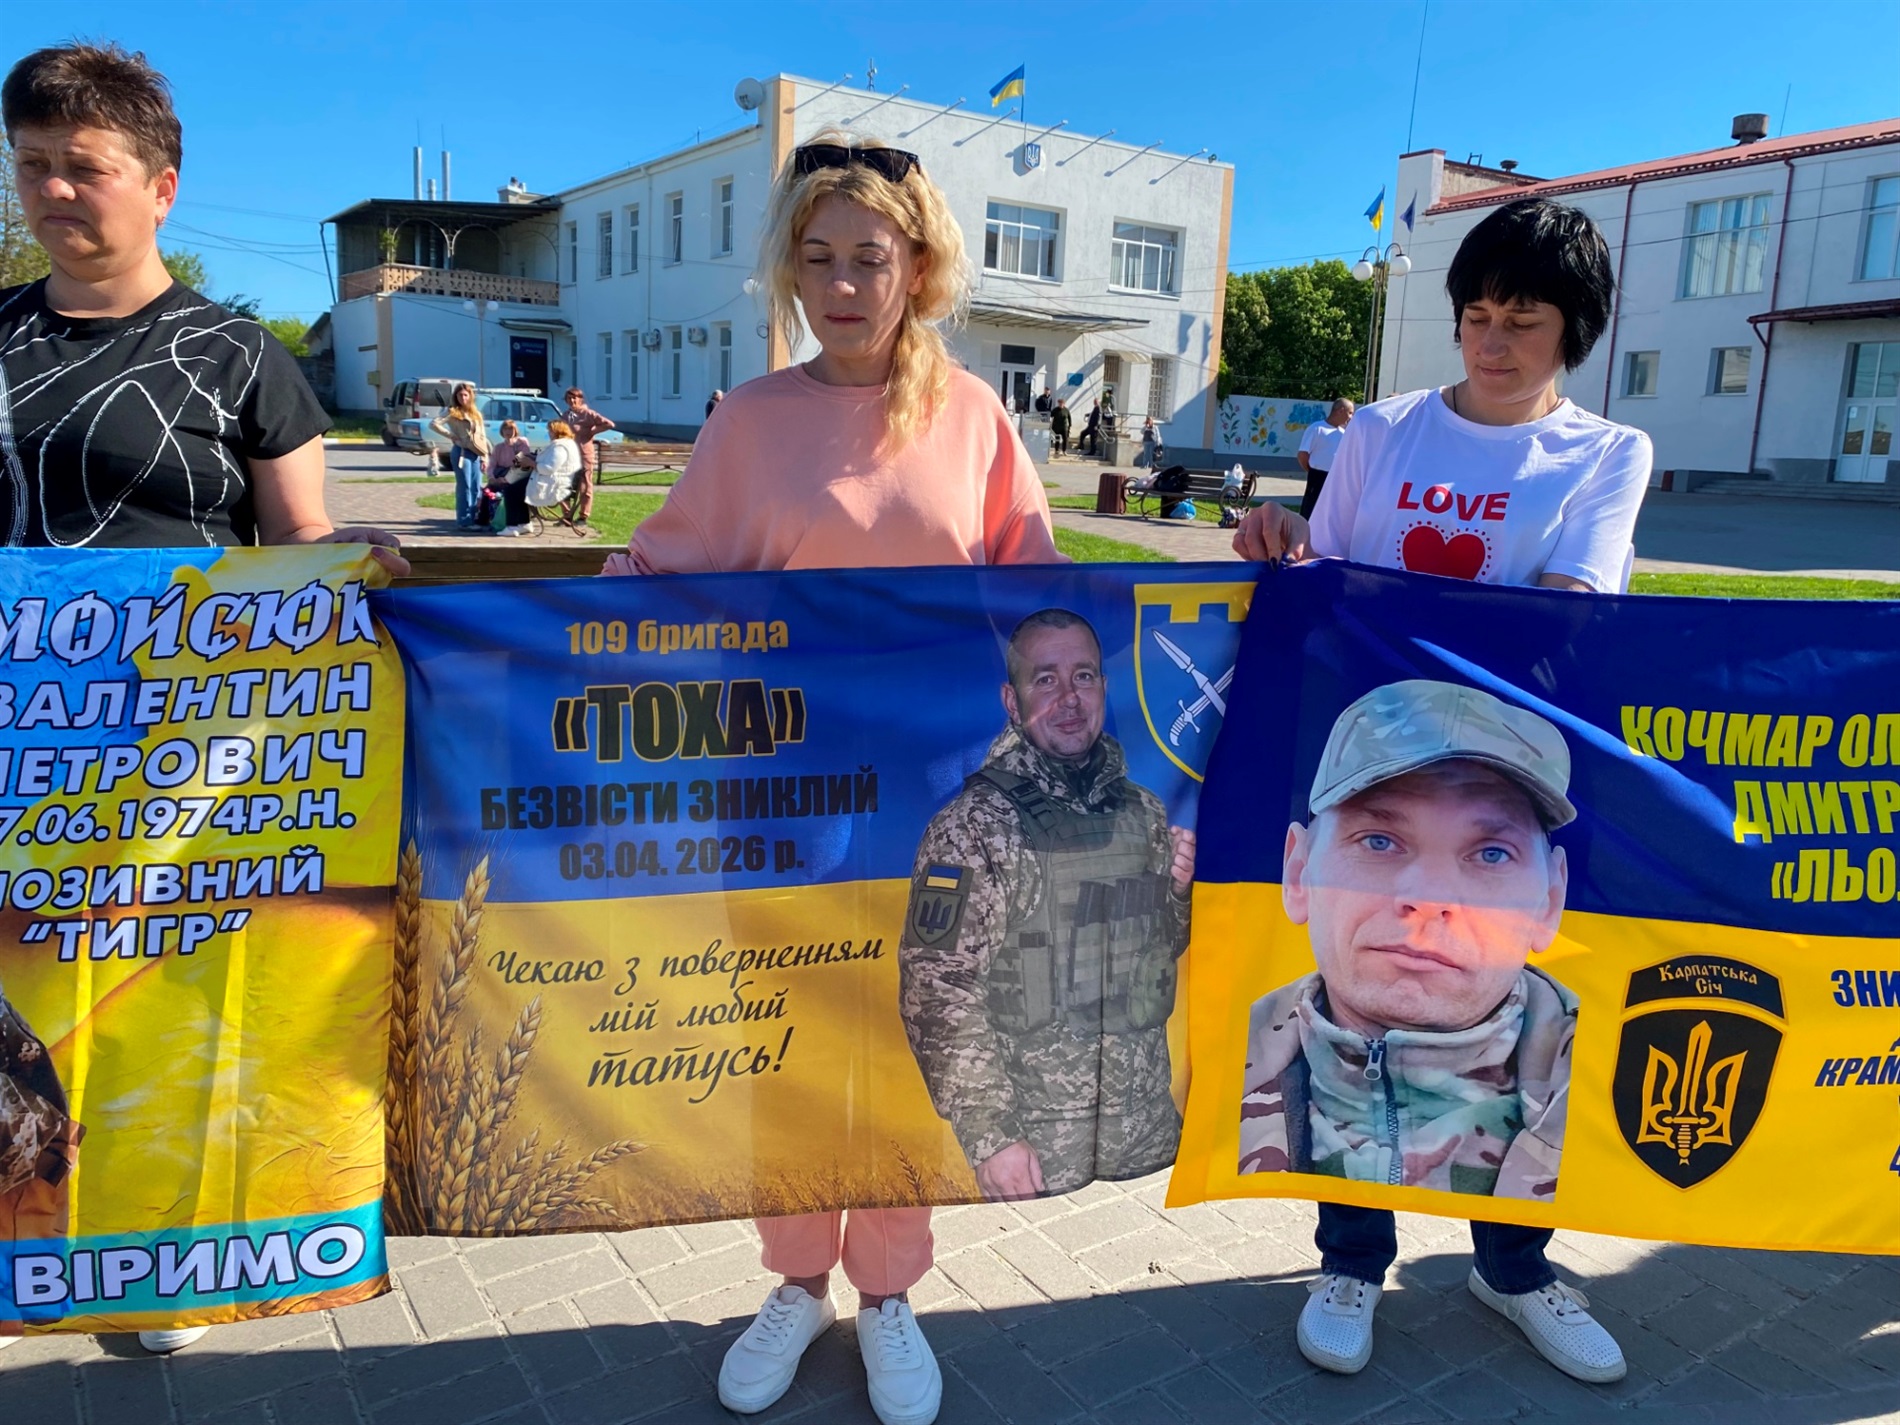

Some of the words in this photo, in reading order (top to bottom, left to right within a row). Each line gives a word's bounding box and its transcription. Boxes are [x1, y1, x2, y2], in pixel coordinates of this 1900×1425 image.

[1397, 482, 1510, 521] LOVE
[565, 620, 628, 655] 109
[638, 620, 789, 655] бригада
[551, 679, 807, 763] «ТОХА»
[1620, 705, 1834, 767] КОЧМАР
[480, 780, 678, 830] БЕЗВІСТИ
[688, 764, 879, 823] ЗНИКЛИЙ
[1733, 781, 1900, 843] ДМИТР
[0, 844, 324, 911] ОЗИВНИЙ
[559, 840, 668, 880] 03.04.
[676, 835, 766, 875] 2026
[775, 839, 804, 874] р.
[1771, 847, 1900, 903] «ЛЬО
[488, 950, 606, 985] Чекаю
[614, 956, 640, 995] з
[660, 938, 885, 988] поверненням
[1658, 964, 1758, 985] Карпатська
[1695, 978, 1723, 994] Січ
[588, 998, 660, 1033] мій
[676, 981, 789, 1028] любий
[587, 1026, 795, 1104] татусь!
[12, 1224, 367, 1307] ВІРИМО
